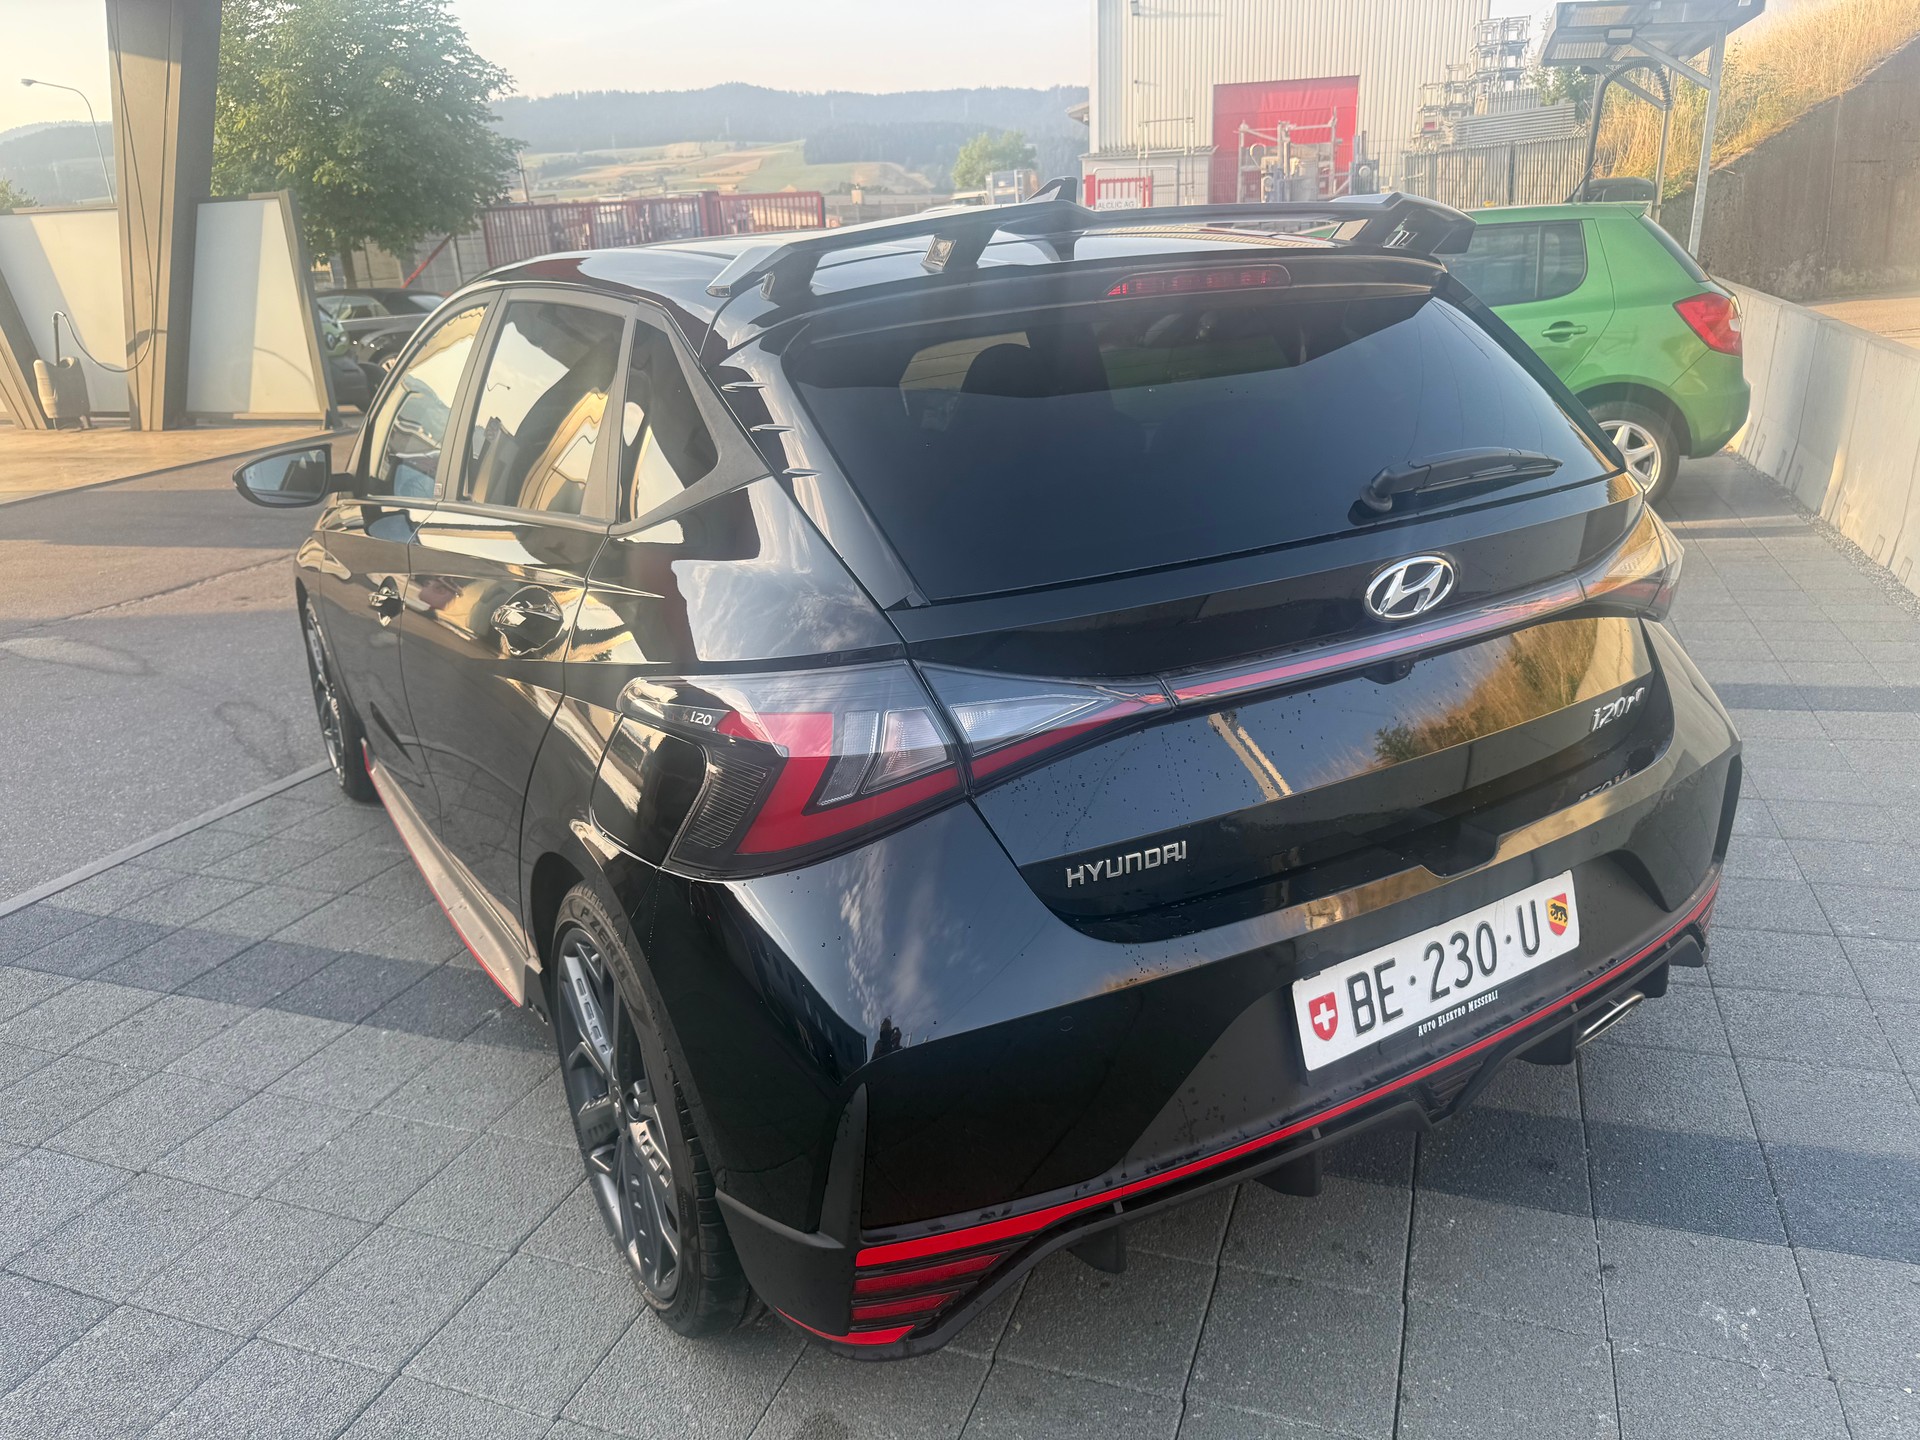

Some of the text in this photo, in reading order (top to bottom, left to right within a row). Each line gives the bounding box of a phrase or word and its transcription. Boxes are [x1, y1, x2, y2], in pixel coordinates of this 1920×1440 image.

[1065, 840, 1187, 888] HYUNDAI
[580, 906, 629, 982] P ZERO
